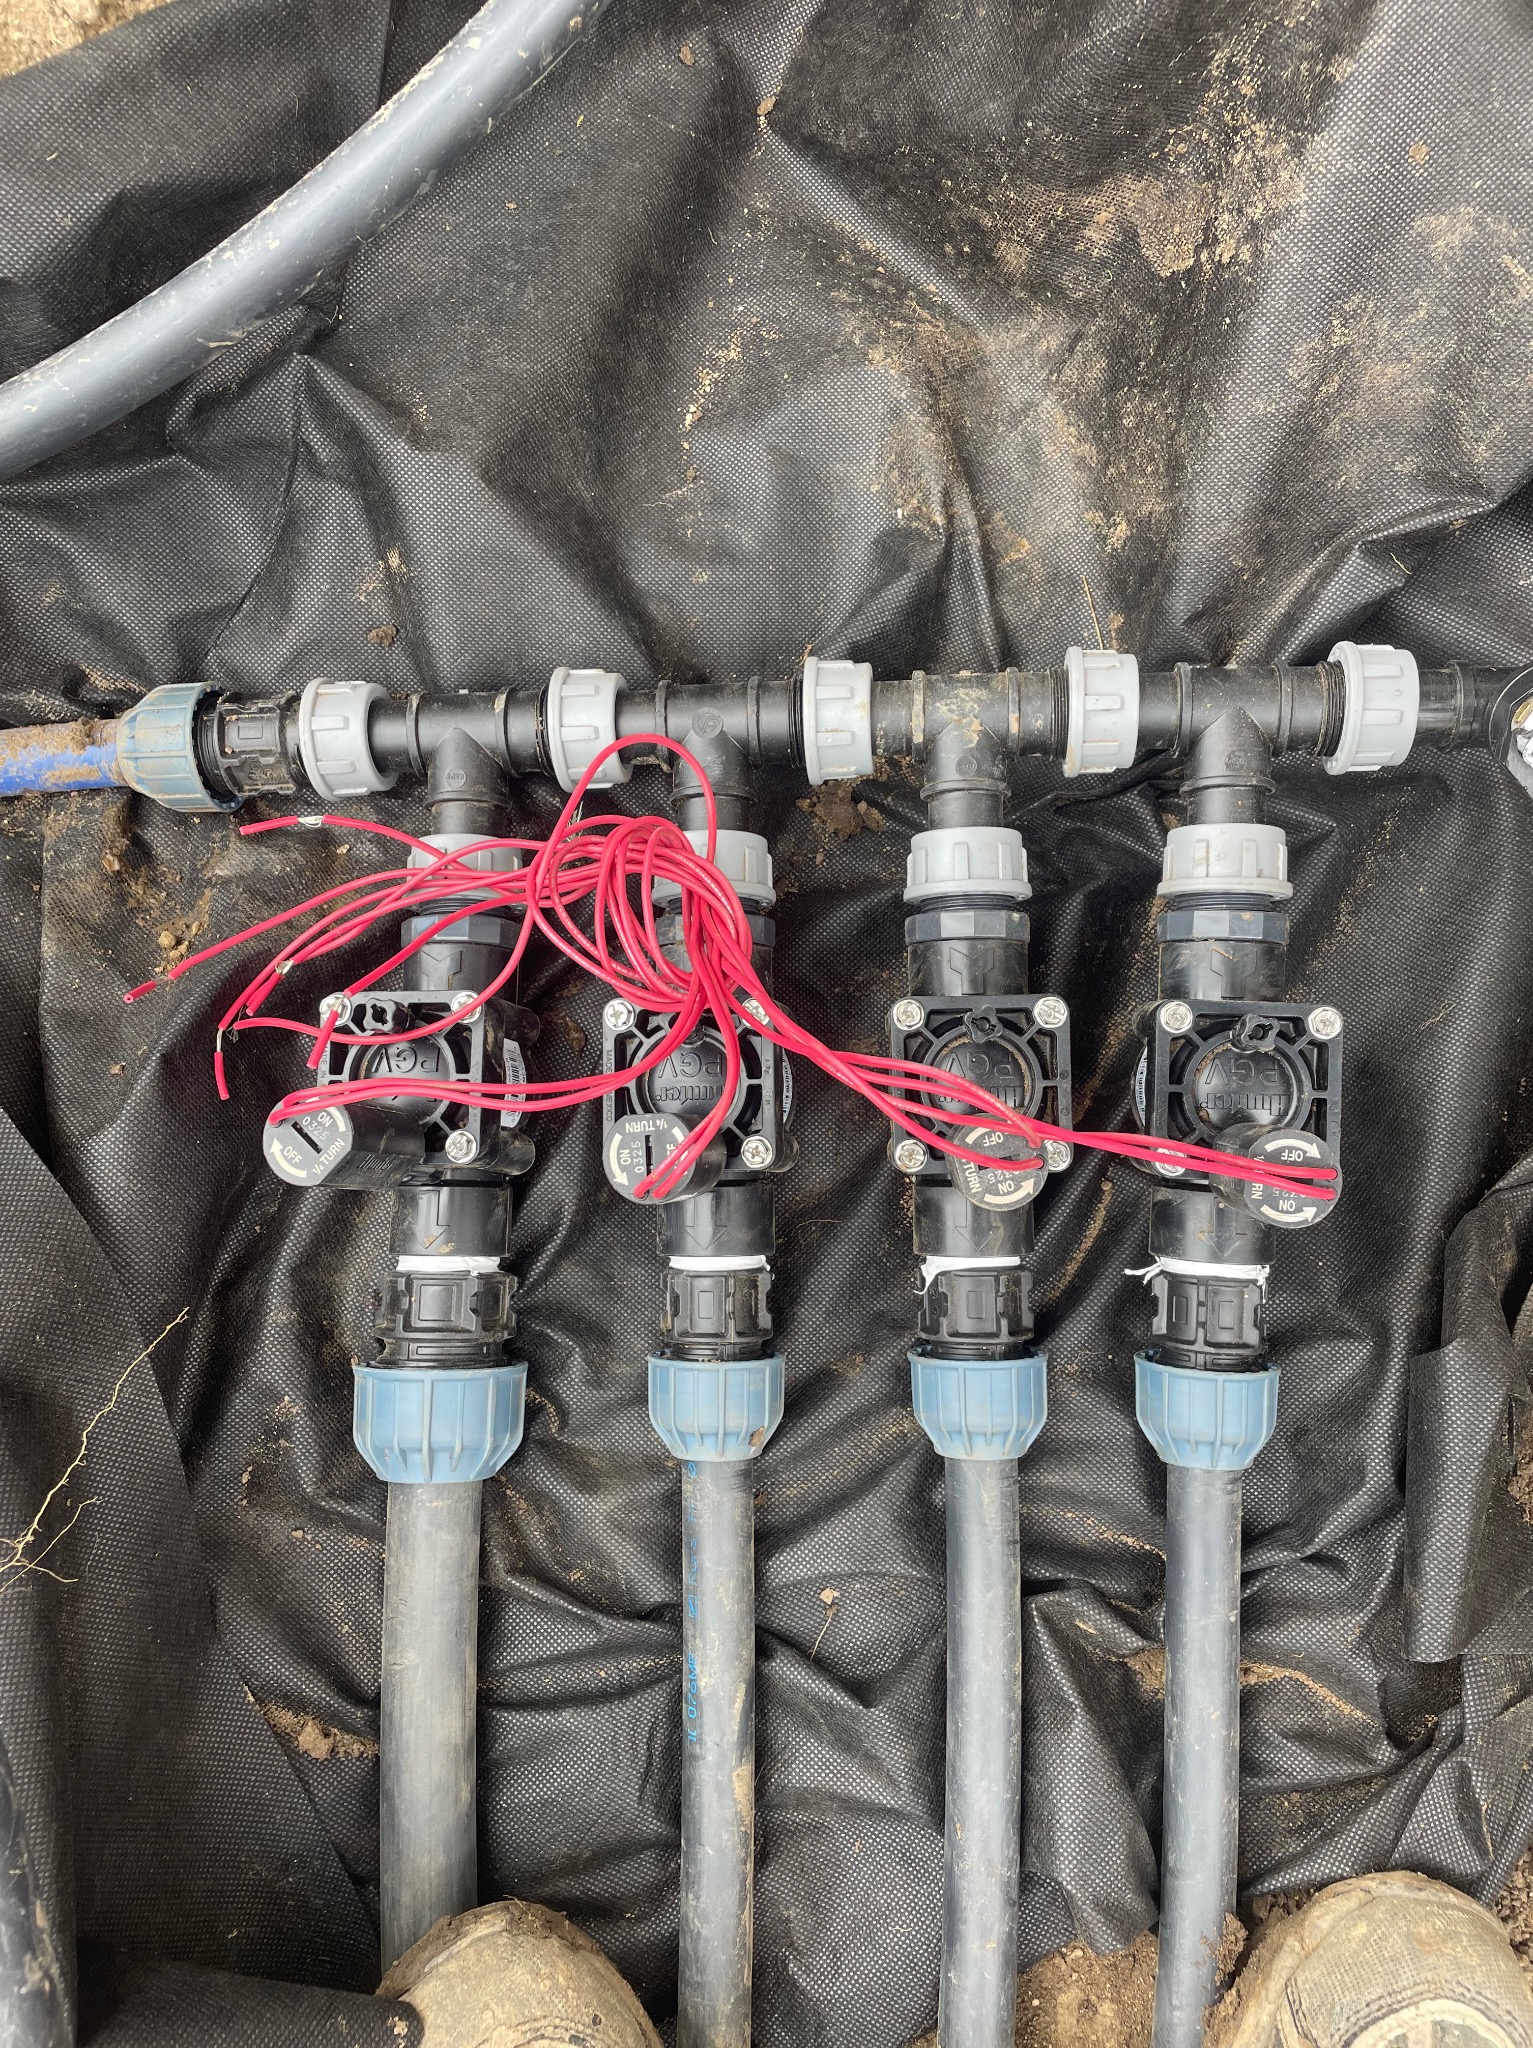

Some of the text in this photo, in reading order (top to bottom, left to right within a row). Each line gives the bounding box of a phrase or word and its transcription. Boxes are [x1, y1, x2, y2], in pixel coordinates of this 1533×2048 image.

[371, 1046, 441, 1074] PGV
[605, 1050, 613, 1073] MADE
[657, 1051, 723, 1079] PGV
[945, 1051, 1015, 1080] PGV
[1205, 1057, 1280, 1086] PGV
[302, 1116, 330, 1141] 0325
[317, 1111, 335, 1128] ON
[625, 1121, 656, 1134] TURN
[982, 1132, 1004, 1147] OFF
[282, 1145, 303, 1166] OFF
[319, 1137, 346, 1168] TURN
[619, 1149, 631, 1165] ON
[632, 1141, 645, 1174] 0325
[1280, 1149, 1304, 1162] OFF
[963, 1162, 982, 1194] TURN
[998, 1180, 1015, 1194] ON
[1279, 1199, 1296, 1212] ON
